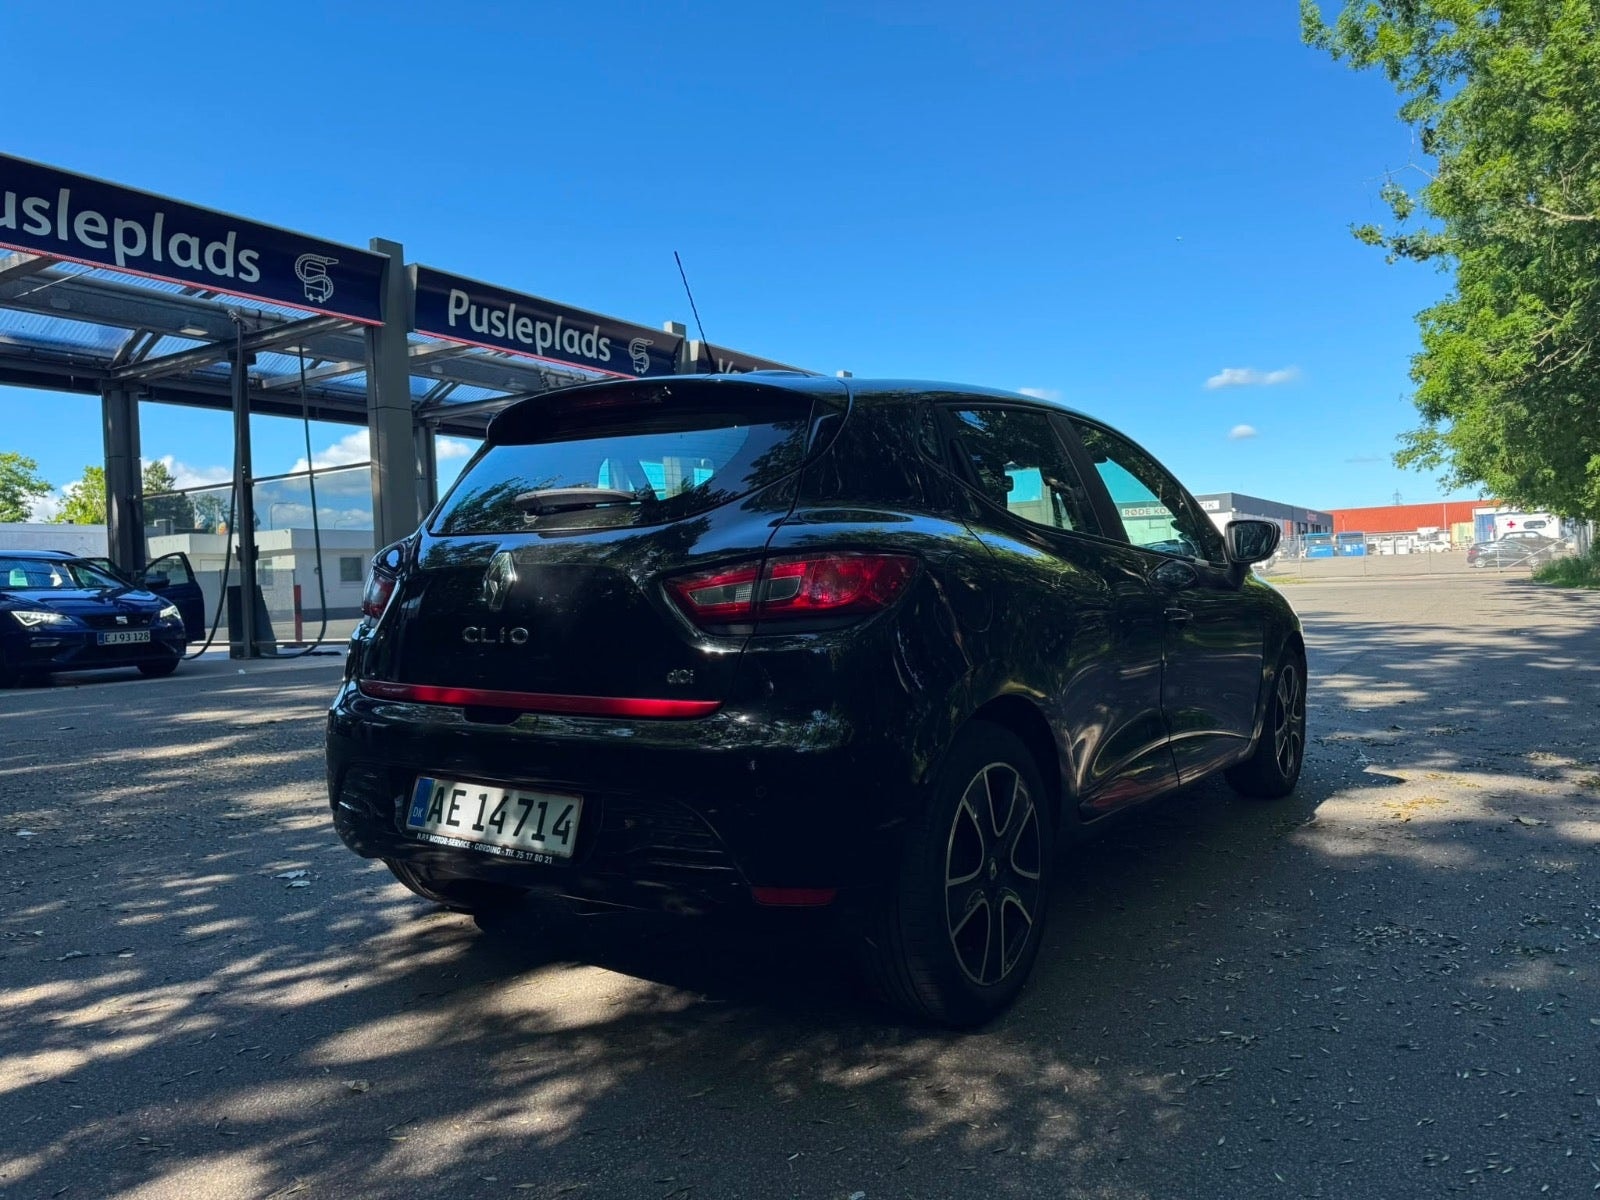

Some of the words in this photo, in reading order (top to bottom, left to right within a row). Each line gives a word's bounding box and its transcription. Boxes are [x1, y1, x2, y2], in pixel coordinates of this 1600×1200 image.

[447, 288, 611, 362] Pusleplads
[1124, 508, 1151, 516] RØDE
[1154, 507, 1170, 515] KO
[105, 634, 117, 643] EJ
[119, 633, 131, 642] 93
[133, 632, 149, 641] 128
[462, 626, 529, 645] CLIO
[412, 806, 424, 818] DK
[426, 786, 467, 827] AE
